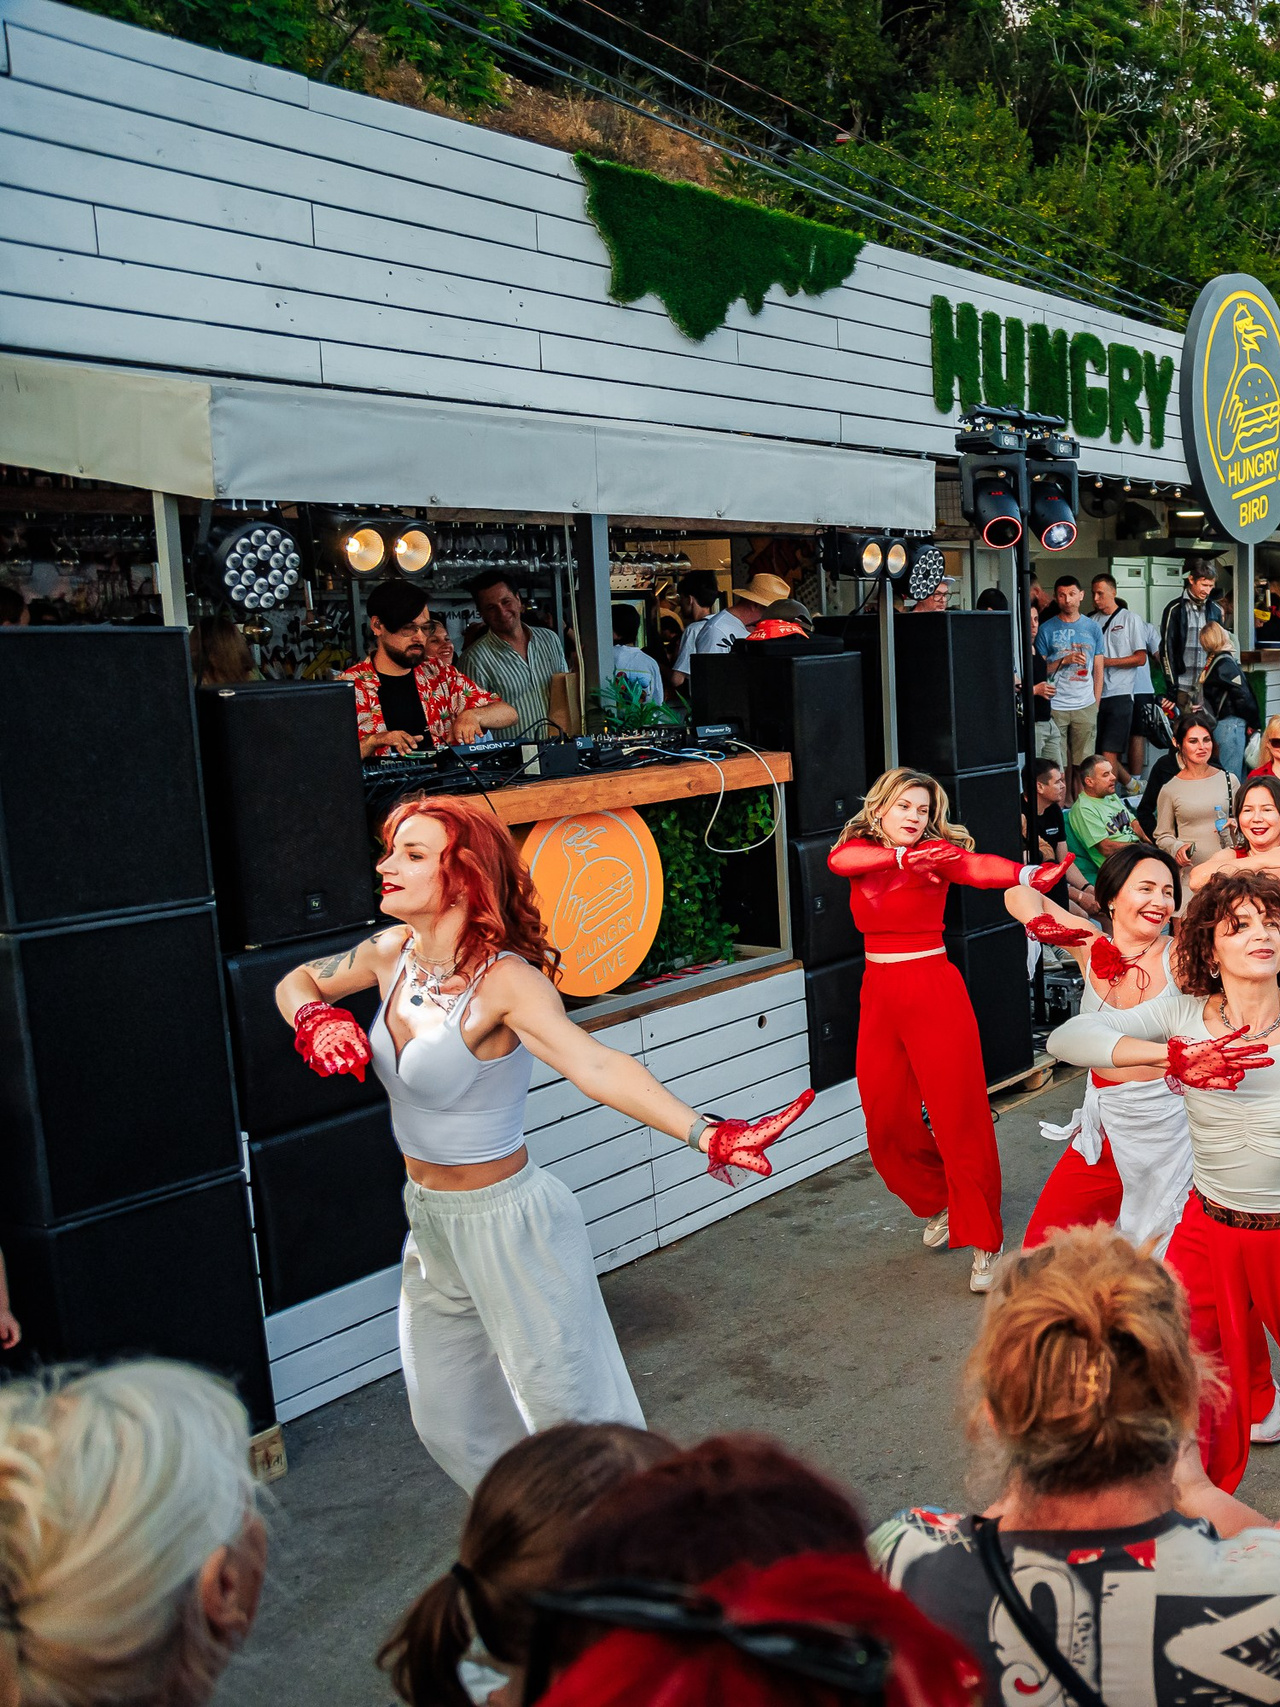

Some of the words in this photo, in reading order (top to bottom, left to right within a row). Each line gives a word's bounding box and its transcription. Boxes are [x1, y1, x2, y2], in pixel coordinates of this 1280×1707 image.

[930, 294, 1174, 449] HUNGRY
[1228, 447, 1279, 487] HUNGRY
[1239, 494, 1269, 527] BIRD
[1052, 628, 1076, 642] EXP
[469, 743, 503, 751] DENON
[576, 910, 634, 965] HUNGRY
[592, 947, 629, 985] LIVE
